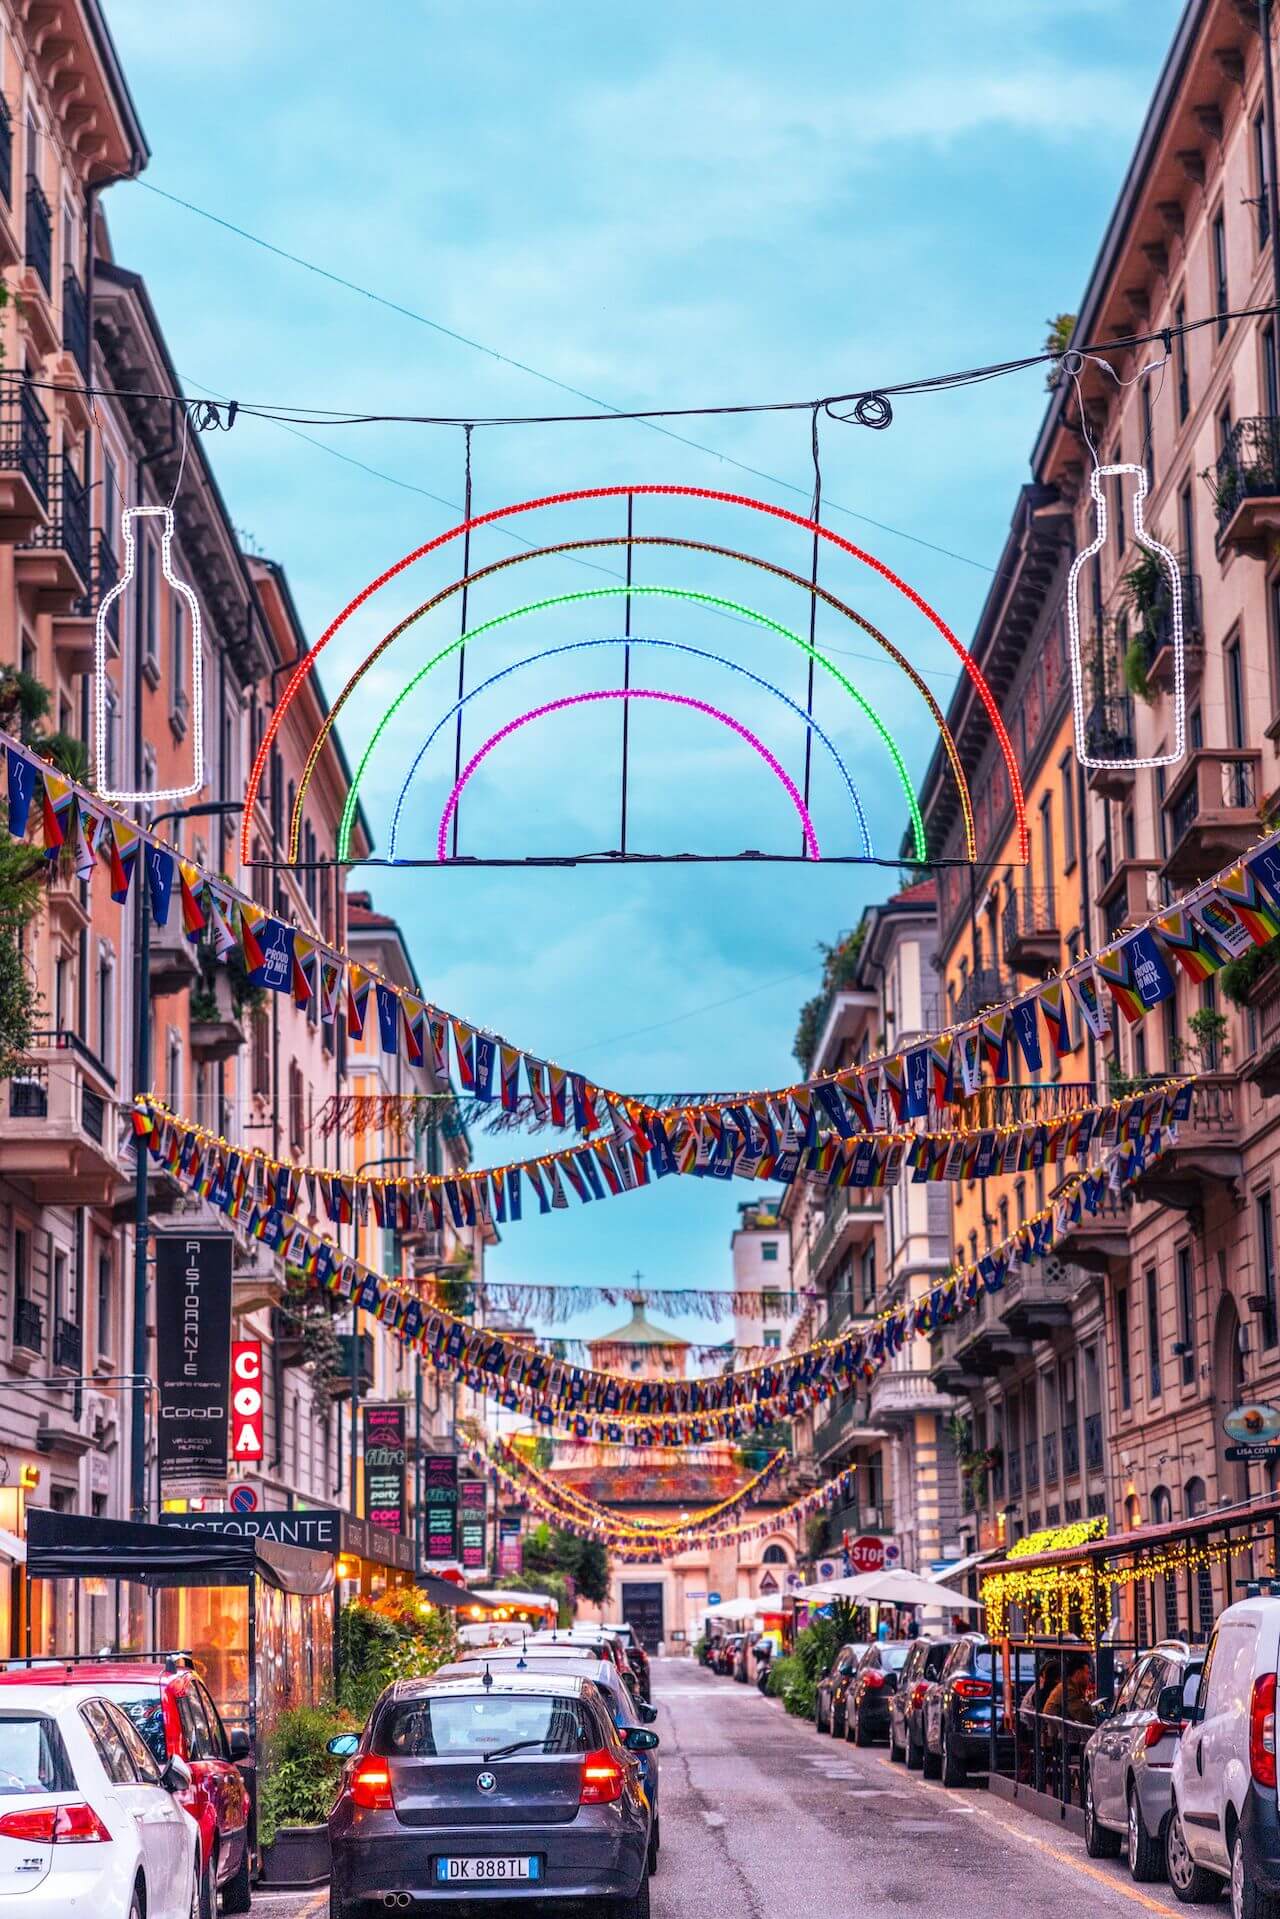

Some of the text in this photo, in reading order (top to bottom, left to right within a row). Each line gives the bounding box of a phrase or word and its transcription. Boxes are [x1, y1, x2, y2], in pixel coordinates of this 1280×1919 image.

[265, 948, 288, 963] PROUD
[274, 962, 287, 974] MIX
[184, 1241, 200, 1376] RISTORANTE
[234, 1352, 261, 1452] COA
[168, 1521, 332, 1542] TORANTE
[853, 1547, 884, 1562] STOP
[450, 1859, 527, 1878] DK 888TL
